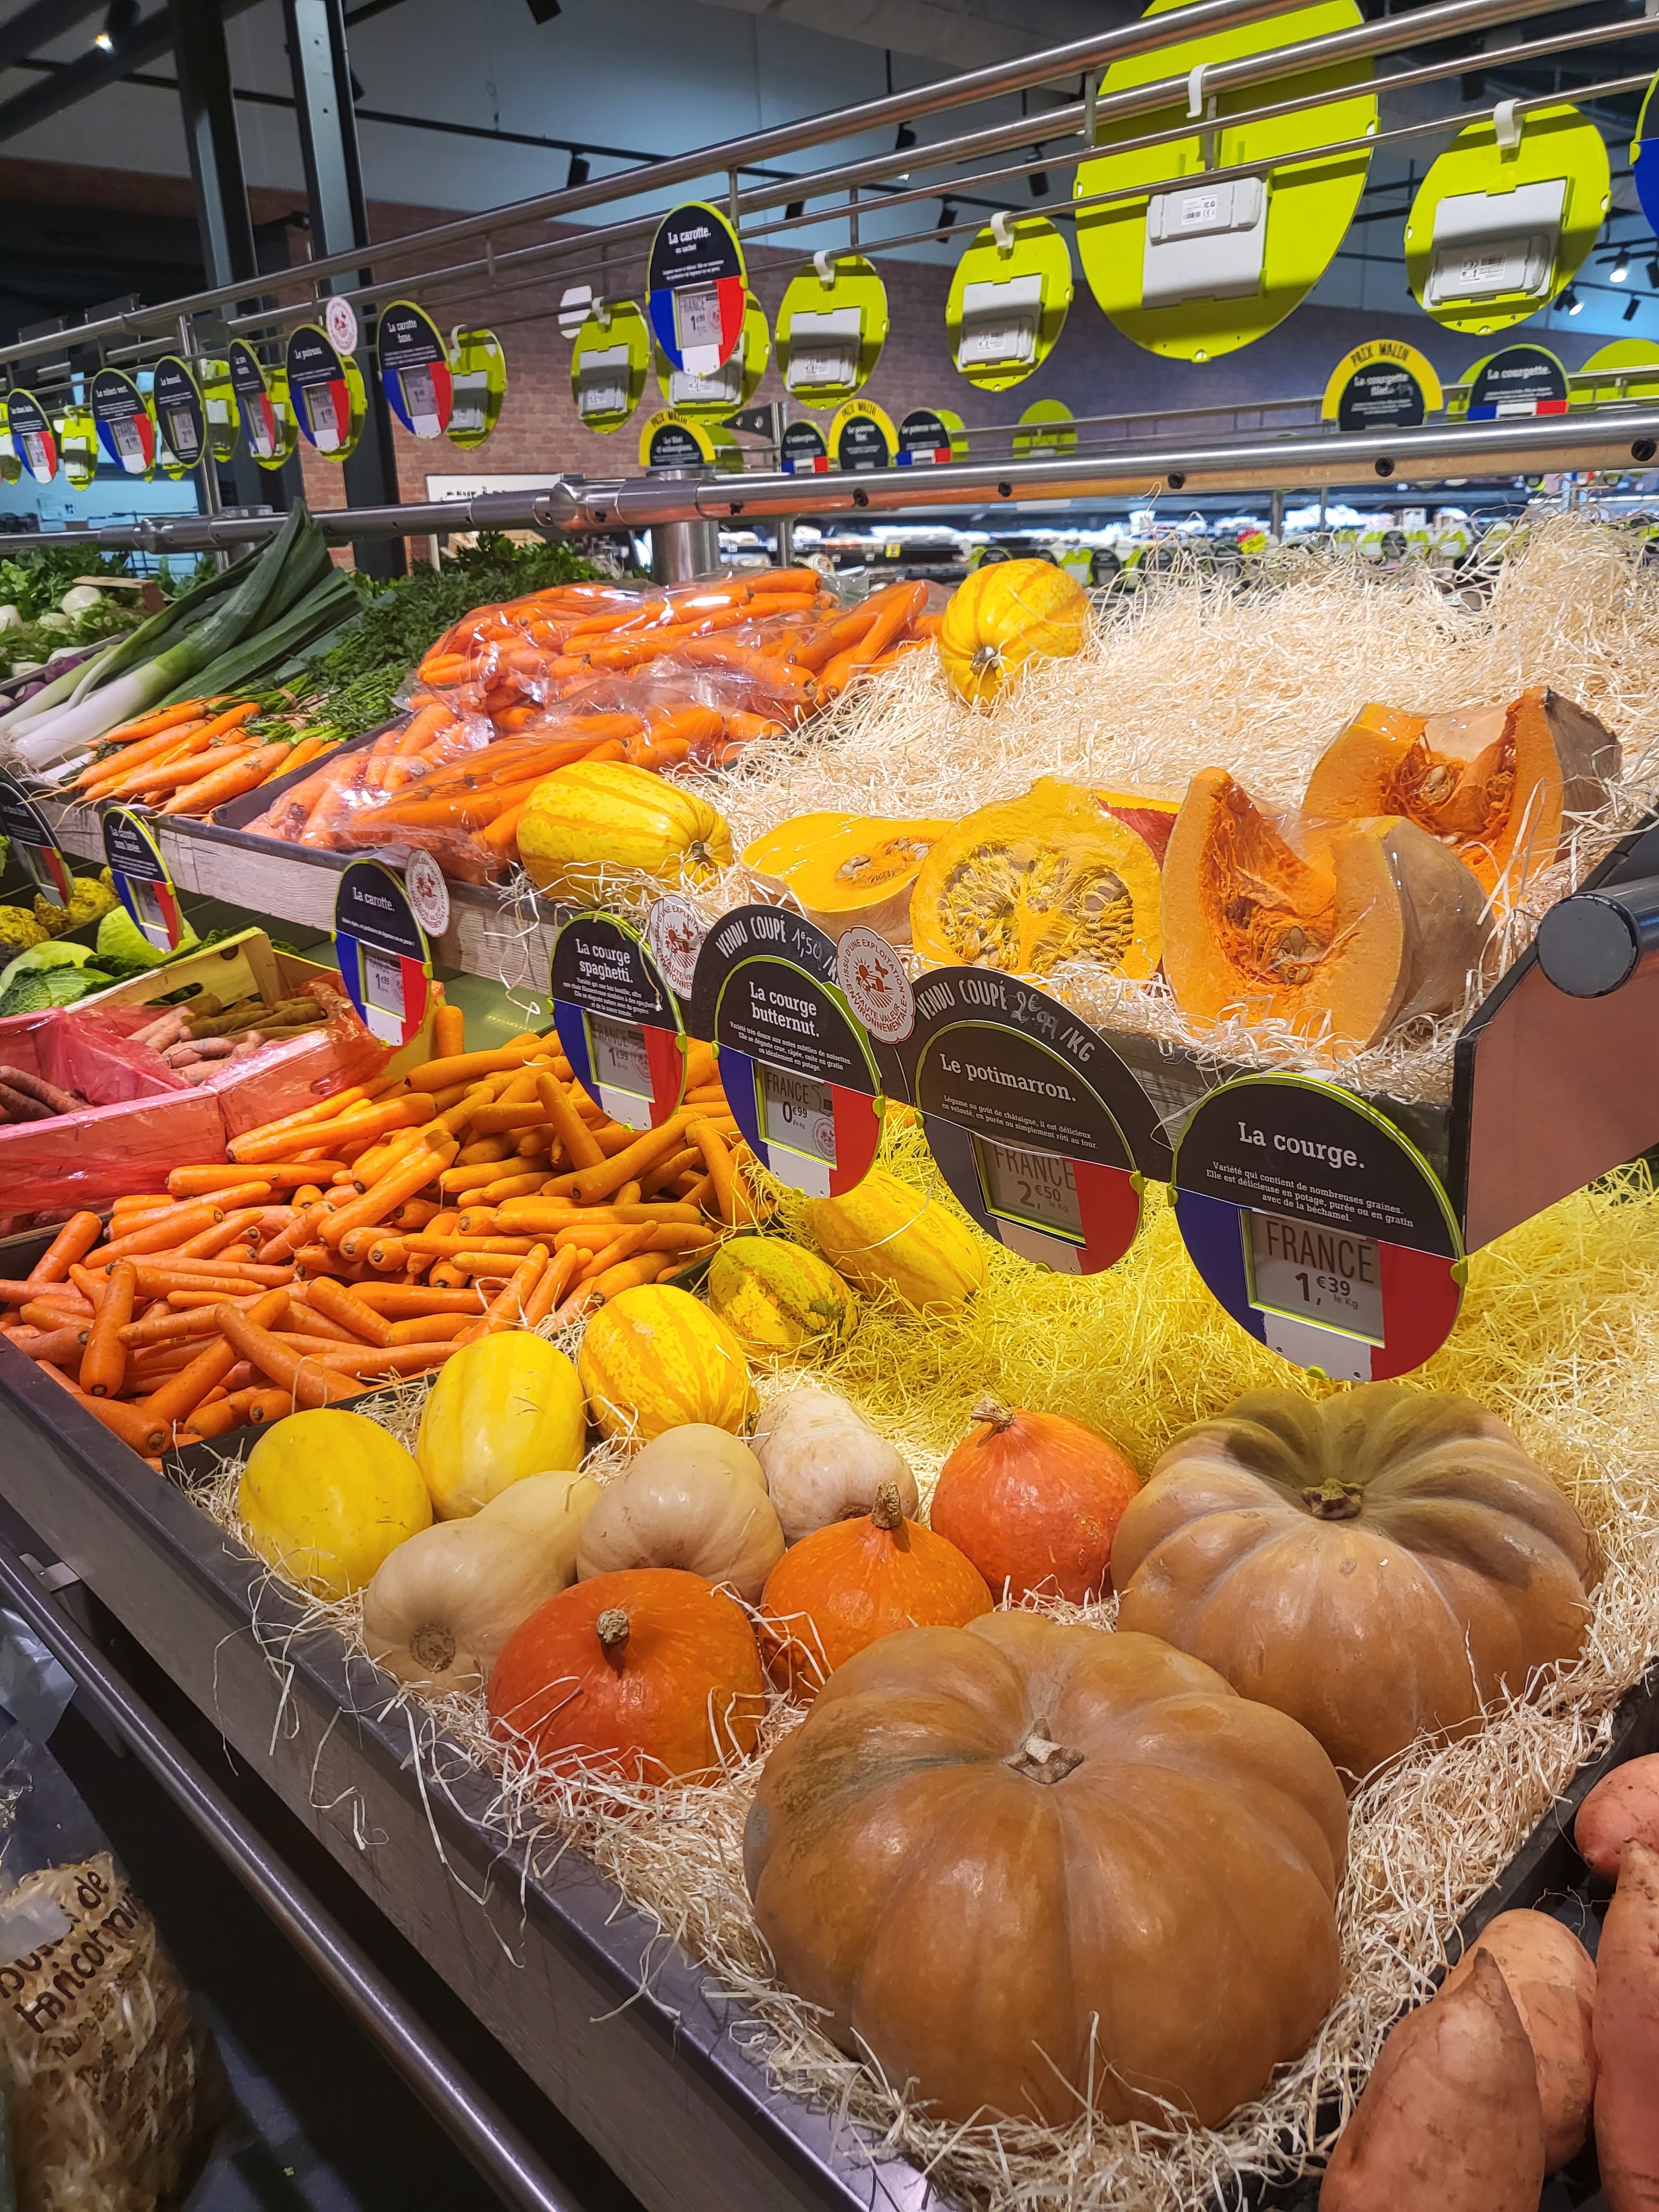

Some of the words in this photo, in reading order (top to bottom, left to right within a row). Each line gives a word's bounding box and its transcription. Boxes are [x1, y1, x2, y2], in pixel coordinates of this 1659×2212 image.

[667, 232, 679, 244] La
[680, 226, 712, 243] carotte.
[1350, 345, 1374, 367] PRIX
[1378, 342, 1410, 361] MALIN
[1487, 368, 1500, 380] La
[1500, 364, 1552, 380] courgette.
[1354, 375, 1366, 387] La
[1366, 373, 1410, 387] courgette
[352, 886, 364, 902] La
[364, 893, 395, 912] carotte.
[575, 938, 591, 956] La
[592, 945, 631, 967] courge
[715, 920, 748, 958] VENDU
[750, 914, 786, 943] COUPÉ
[580, 961, 633, 984] spaghetti.
[665, 955, 684, 978] HAUTE
[846, 938, 862, 958] D'UNE
[862, 938, 906, 993] EXPLOITATION
[749, 981, 766, 1001] La
[769, 990, 817, 1018] courge
[846, 983, 908, 1033] ENVIRONNEMENTALE
[855, 992, 879, 1020] HAUTE
[879, 1003, 901, 1023] VALEUR
[916, 981, 956, 1020] VENDU
[958, 979, 1008, 1011] COUPÉ
[750, 1001, 820, 1038] butternut.
[729, 1020, 747, 1032] Variété
[746, 1026, 757, 1036] très
[757, 1030, 772, 1041] douce
[772, 1035, 781, 1044] aux
[782, 1039, 796, 1049] notes
[796, 1043, 818, 1055] subtiles
[818, 1048, 826, 1058] de
[738, 1031, 748, 1041] Elle
[754, 1037, 774, 1050] déguste
[774, 1044, 787, 1054] crue,
[805, 1053, 818, 1063] cuite
[819, 1057, 826, 1066] en
[827, 1060, 844, 1071] gratin
[765, 1047, 794, 1064] idéalement
[802, 1061, 822, 1072] potage.
[939, 1053, 962, 1074] Le
[964, 1062, 1077, 1102] potimarron.
[766, 1071, 810, 1105] FRANCE
[941, 1102, 950, 1110] en
[950, 1104, 975, 1118] velouté,
[975, 1112, 985, 1120] en
[985, 1115, 1005, 1126] purée
[1005, 1120, 1014, 1129] ou
[1015, 1122, 1056, 1140] simplement
[1056, 1132, 1070, 1142] rôti
[1070, 1137, 1081, 1145] au
[1081, 1139, 1099, 1150] four.
[943, 1094, 968, 1108] Légume
[969, 1102, 978, 1110] au
[978, 1103, 993, 1116] goût
[994, 1108, 1003, 1118] de
[1004, 1111, 1039, 1127] châtaigne,
[1039, 1120, 1046, 1129] il
[1046, 1123, 1058, 1131] est
[1058, 1125, 1092, 1140] délicieux
[1238, 1121, 1266, 1148] La
[1274, 1133, 1365, 1170] courge.
[994, 1142, 1078, 1191] FRANCE
[1206, 1168, 1222, 1180] Elle
[1223, 1175, 1237, 1184] est
[1238, 1177, 1280, 1194] délicieuse
[1281, 1190, 1293, 1198] en
[1294, 1192, 1327, 1207] potage,
[1328, 1201, 1355, 1213] purée
[1357, 1207, 1369, 1217] ou
[1371, 1211, 1383, 1220] en
[1385, 1214, 1414, 1228] gratin
[1212, 1161, 1243, 1176] Variété
[1244, 1170, 1259, 1180] qui
[1260, 1174, 1295, 1188] contient
[1296, 1182, 1308, 1192] de
[1309, 1186, 1364, 1206] nombreuses
[1366, 1199, 1404, 1214] graines.
[1262, 1193, 1282, 1204] avec
[1283, 1198, 1294, 1208] de
[1295, 1201, 1305, 1211] la
[1306, 1203, 1353, 1222] béchamel.
[1266, 1220, 1374, 1284] FRANCE
[1333, 1293, 1343, 1304] le
[74, 1871, 109, 1910] de
